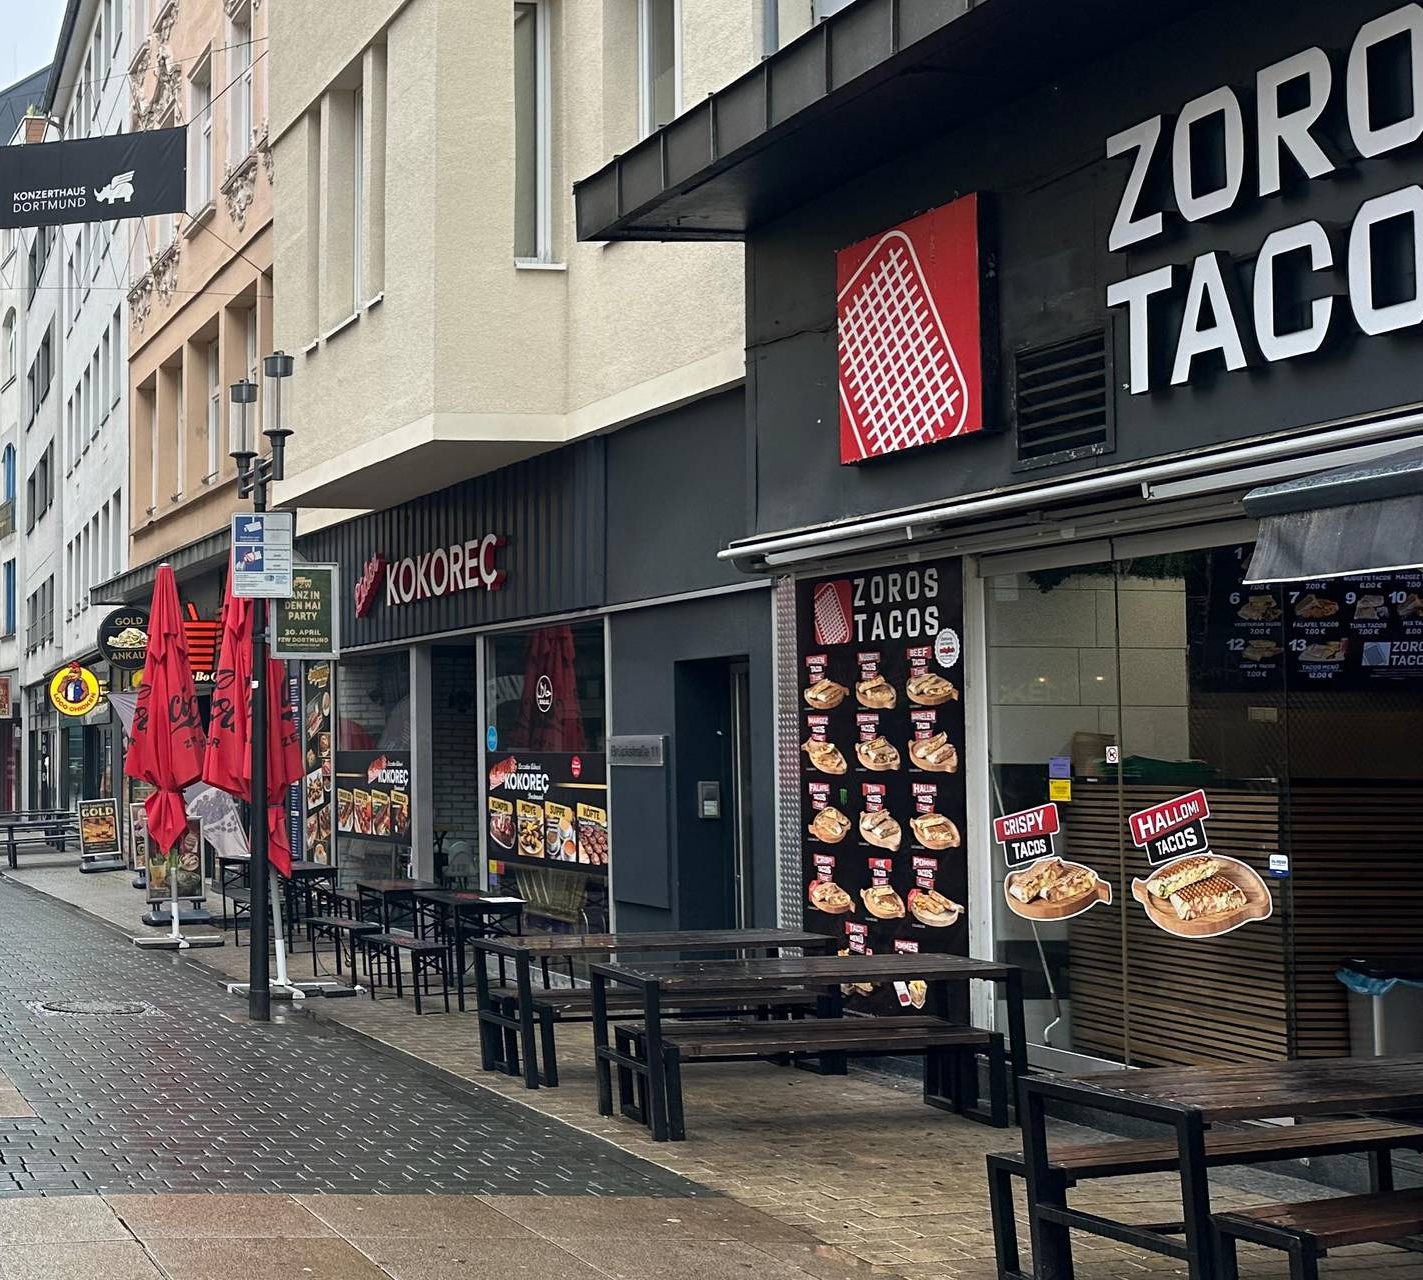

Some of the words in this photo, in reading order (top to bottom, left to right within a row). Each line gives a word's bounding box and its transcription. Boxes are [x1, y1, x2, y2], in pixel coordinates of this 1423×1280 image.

[13, 186, 86, 201] KONZERTHAUS
[13, 198, 86, 213] DORTMUND
[386, 533, 499, 607] KOKOREÇ
[853, 567, 939, 607] ZOROS
[292, 591, 308, 600] ANZ
[1229, 592, 1240, 604] 6
[1289, 591, 1300, 604] 7
[1345, 592, 1356, 604] 9
[1388, 591, 1407, 604] 10
[285, 601, 303, 610] DEN
[305, 601, 321, 610] MAI
[114, 617, 144, 626] GOLD
[288, 612, 317, 620] PARTY
[854, 605, 939, 642] TACOS
[1226, 639, 1245, 651] 12
[1289, 639, 1307, 651] 13
[112, 651, 145, 660] ANKAU
[53, 692, 68, 711] LOCO
[68, 692, 96, 712] CHICKEN
[378, 769, 409, 786] KOKOREÇ
[504, 773, 550, 793] KOKOREÇ
[81, 807, 114, 817] GOLD
[1003, 809, 1047, 836] CRISPY
[1137, 799, 1200, 841] HALLOMI
[1155, 827, 1198, 856] TACOS
[1012, 838, 1047, 860] TACOS
